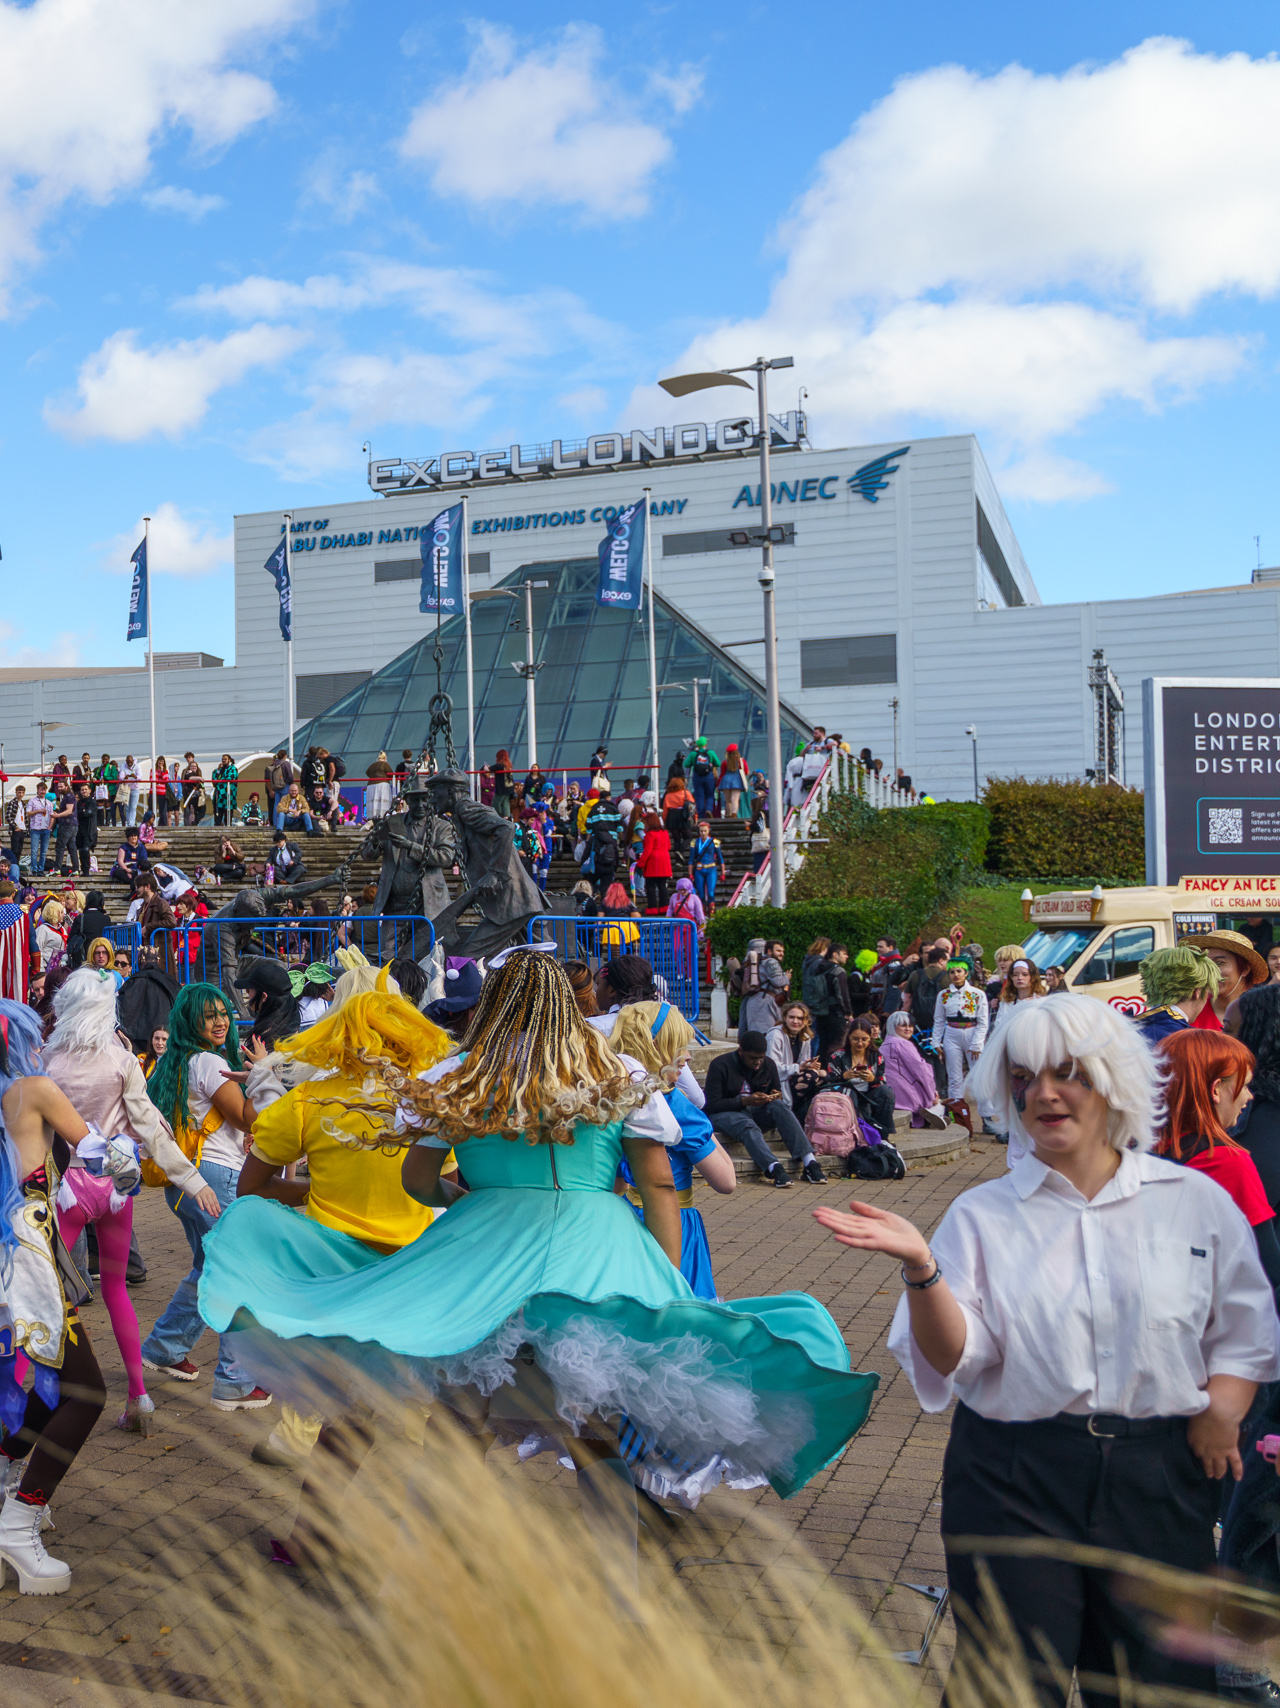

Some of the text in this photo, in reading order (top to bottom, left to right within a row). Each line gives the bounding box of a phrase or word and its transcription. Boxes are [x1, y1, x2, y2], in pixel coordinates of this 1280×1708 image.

[313, 519, 329, 530] OF
[289, 536, 317, 553] BU
[319, 531, 373, 549] DHABI
[471, 509, 585, 534] EXHIBITIONS
[1194, 712, 1280, 728] LONDO
[1185, 879, 1276, 891] FANCY AN ICE
[1210, 898, 1224, 907] ICE
[1228, 898, 1261, 907] CREAM
